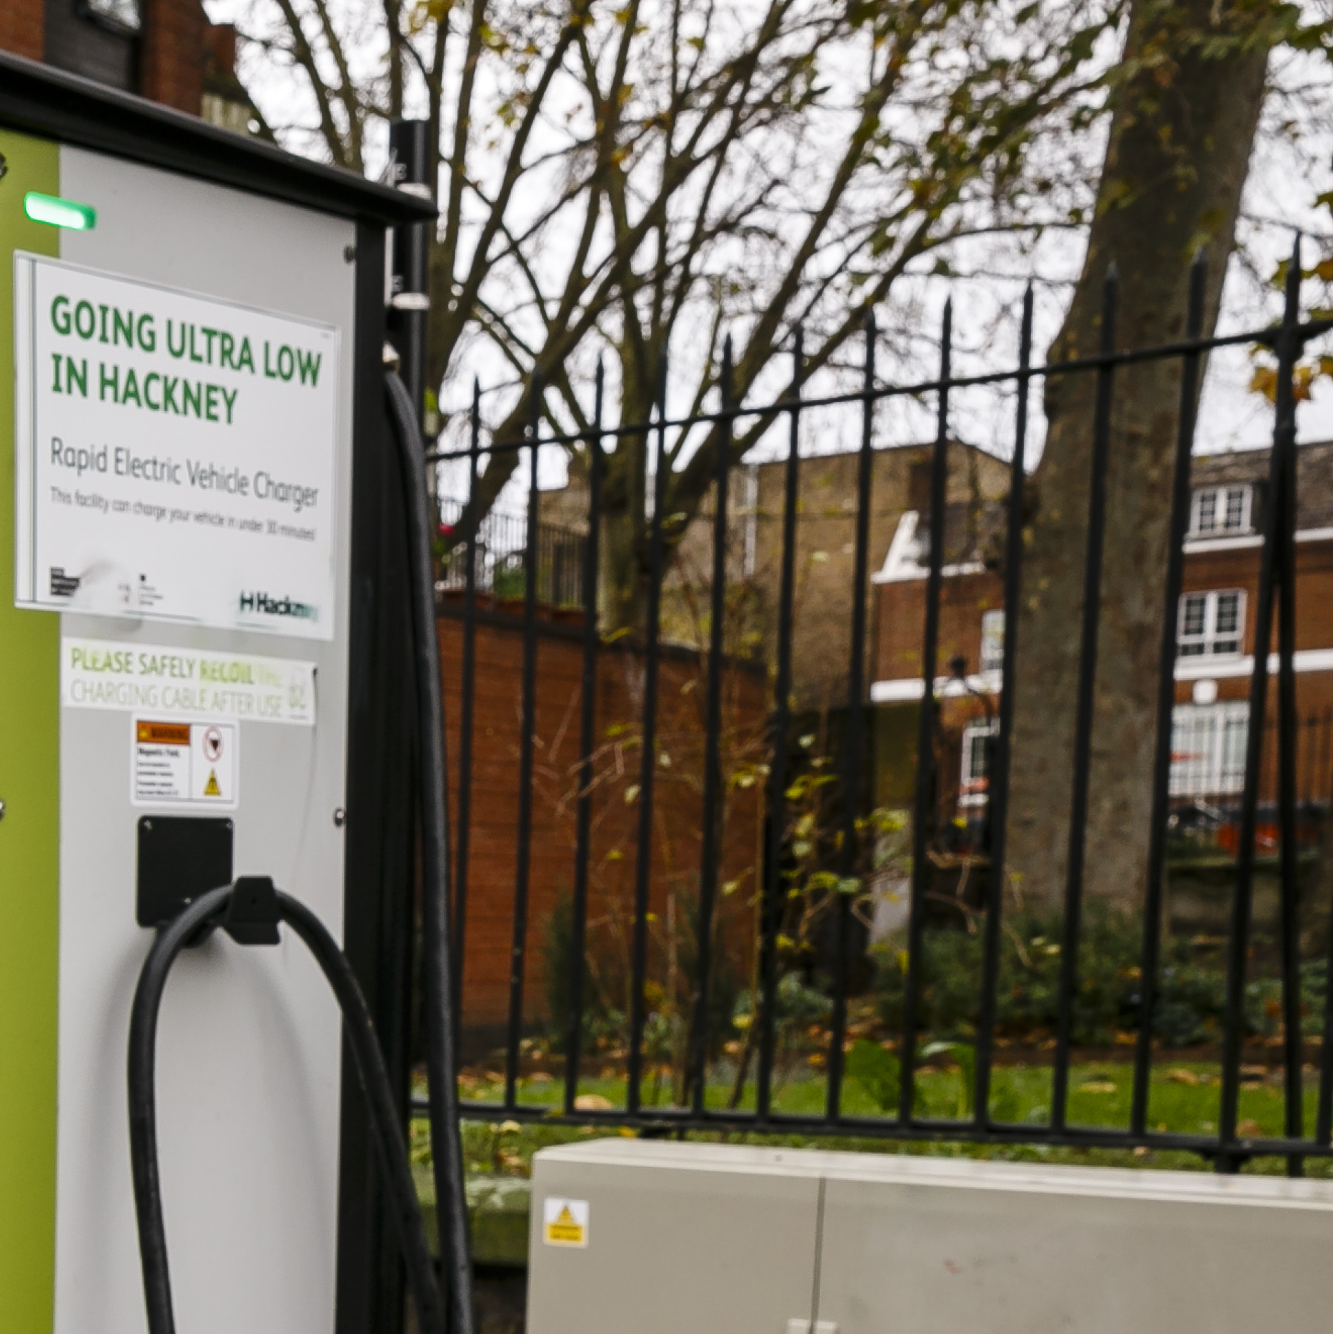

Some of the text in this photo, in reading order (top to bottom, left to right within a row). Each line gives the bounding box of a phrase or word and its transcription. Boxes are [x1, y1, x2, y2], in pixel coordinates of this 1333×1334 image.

[51, 295, 322, 387] GOING ULTRA LOW
[51, 353, 238, 425] IN HACKNEY
[51, 436, 318, 513] Rapid Electric Vehicle Charger
[70, 680, 157, 707] CHARGING
[71, 647, 133, 674] PLEASE
[138, 653, 195, 678] SAFELY
